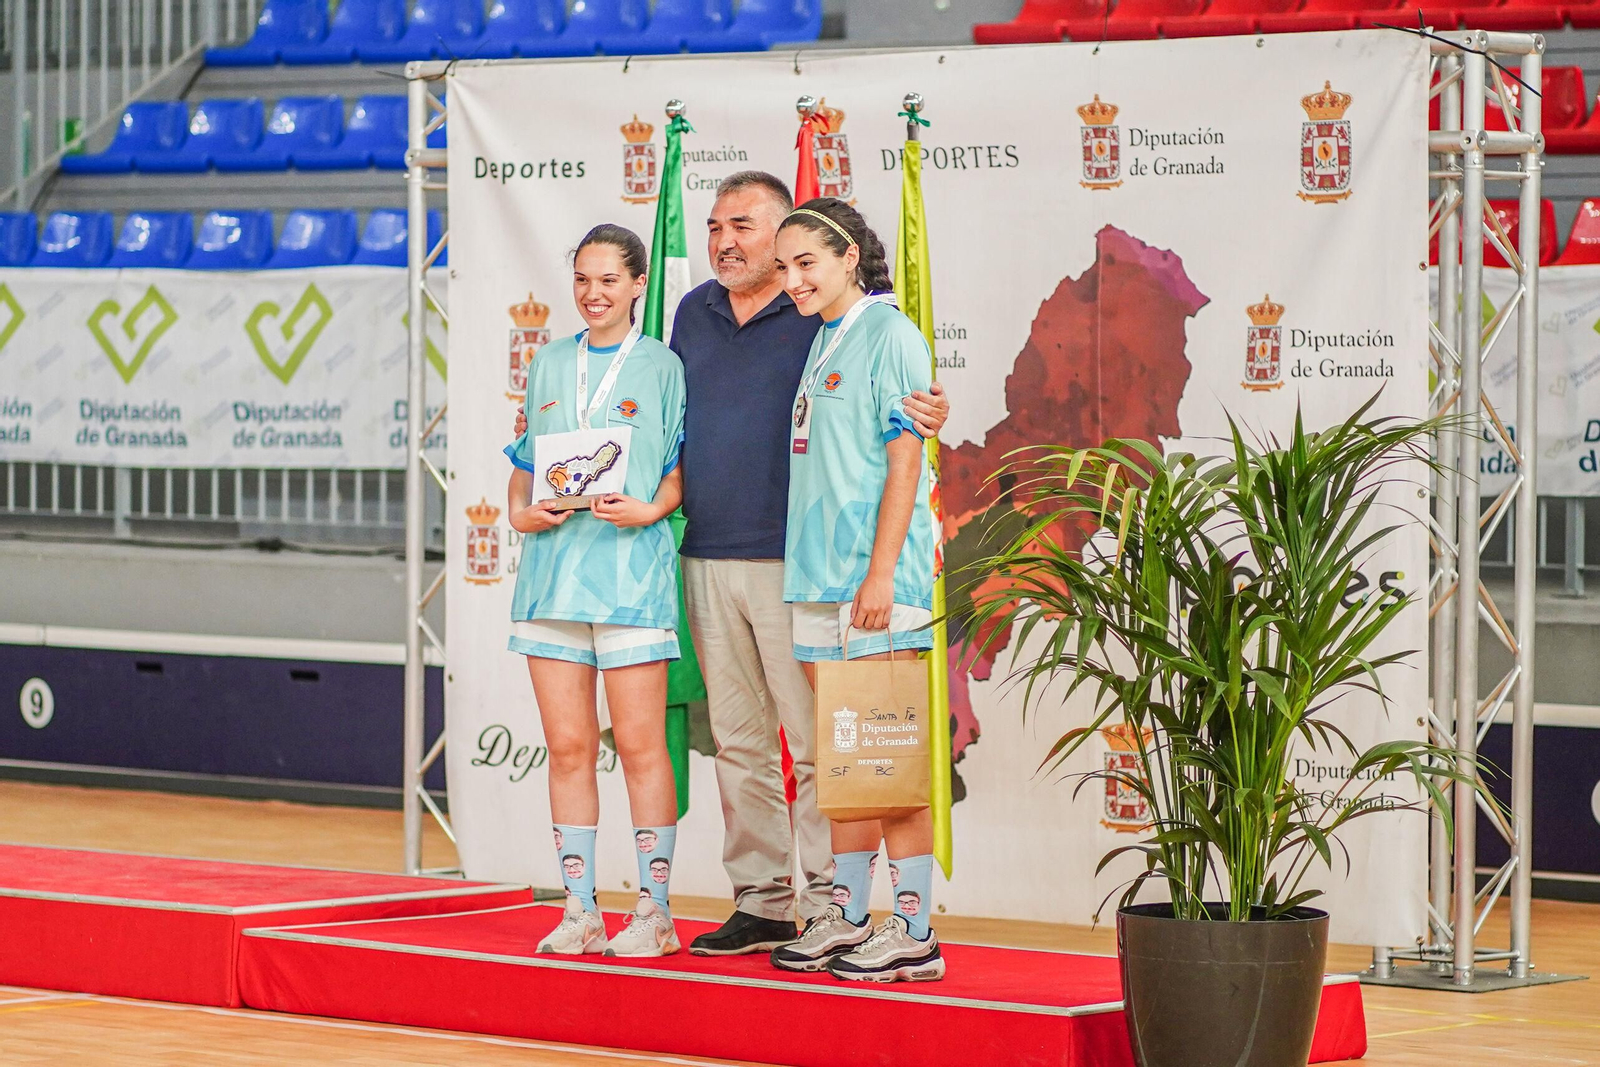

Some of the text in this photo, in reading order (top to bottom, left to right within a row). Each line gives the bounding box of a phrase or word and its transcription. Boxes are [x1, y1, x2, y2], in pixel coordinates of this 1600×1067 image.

[1129, 127, 1224, 150] Diputación
[682, 145, 748, 167] putación
[1129, 155, 1224, 176] de Granada
[475, 156, 585, 184] Deportes
[1290, 328, 1394, 352] Diputación
[1291, 358, 1394, 377] de Granada
[79, 398, 181, 423] Diputación
[233, 399, 342, 424] Diputación
[75, 424, 188, 447] de Granada
[232, 426, 342, 447] de Granada
[31, 688, 43, 717] 9
[861, 723, 918, 735] Diputación
[862, 736, 918, 747] de Granada
[471, 724, 617, 782] Depes
[858, 758, 893, 766] DEPORTES
[875, 766, 894, 776] BC
